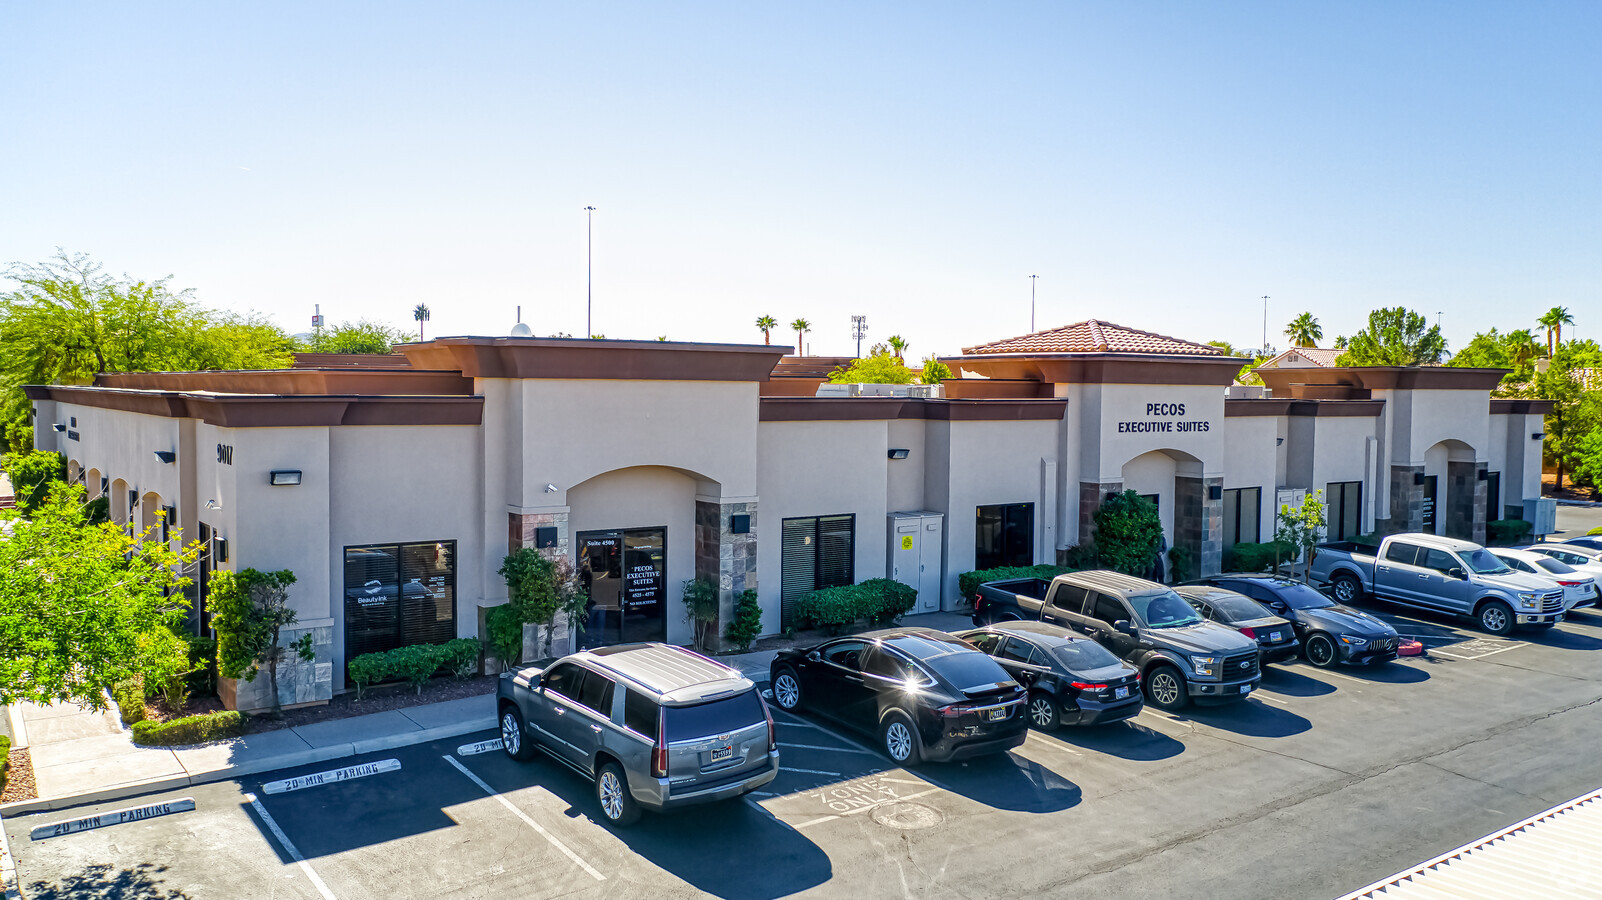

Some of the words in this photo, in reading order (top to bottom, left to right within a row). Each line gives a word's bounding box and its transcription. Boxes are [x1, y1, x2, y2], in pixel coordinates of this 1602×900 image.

[1146, 403, 1186, 416] PECOS
[1118, 421, 1173, 433] EXECUTIVE
[1176, 421, 1210, 432] SUITES
[216, 443, 234, 466] 9017
[627, 571, 660, 579] EXECUTIVE
[473, 743, 487, 753] 20
[491, 740, 504, 750] MI
[284, 780, 300, 791] 20
[305, 774, 324, 786] MIN
[335, 763, 379, 781] PARKING
[828, 788, 900, 812] ONLY
[54, 821, 70, 834] 20
[79, 815, 101, 830] MIN
[119, 803, 171, 822] PARKING
